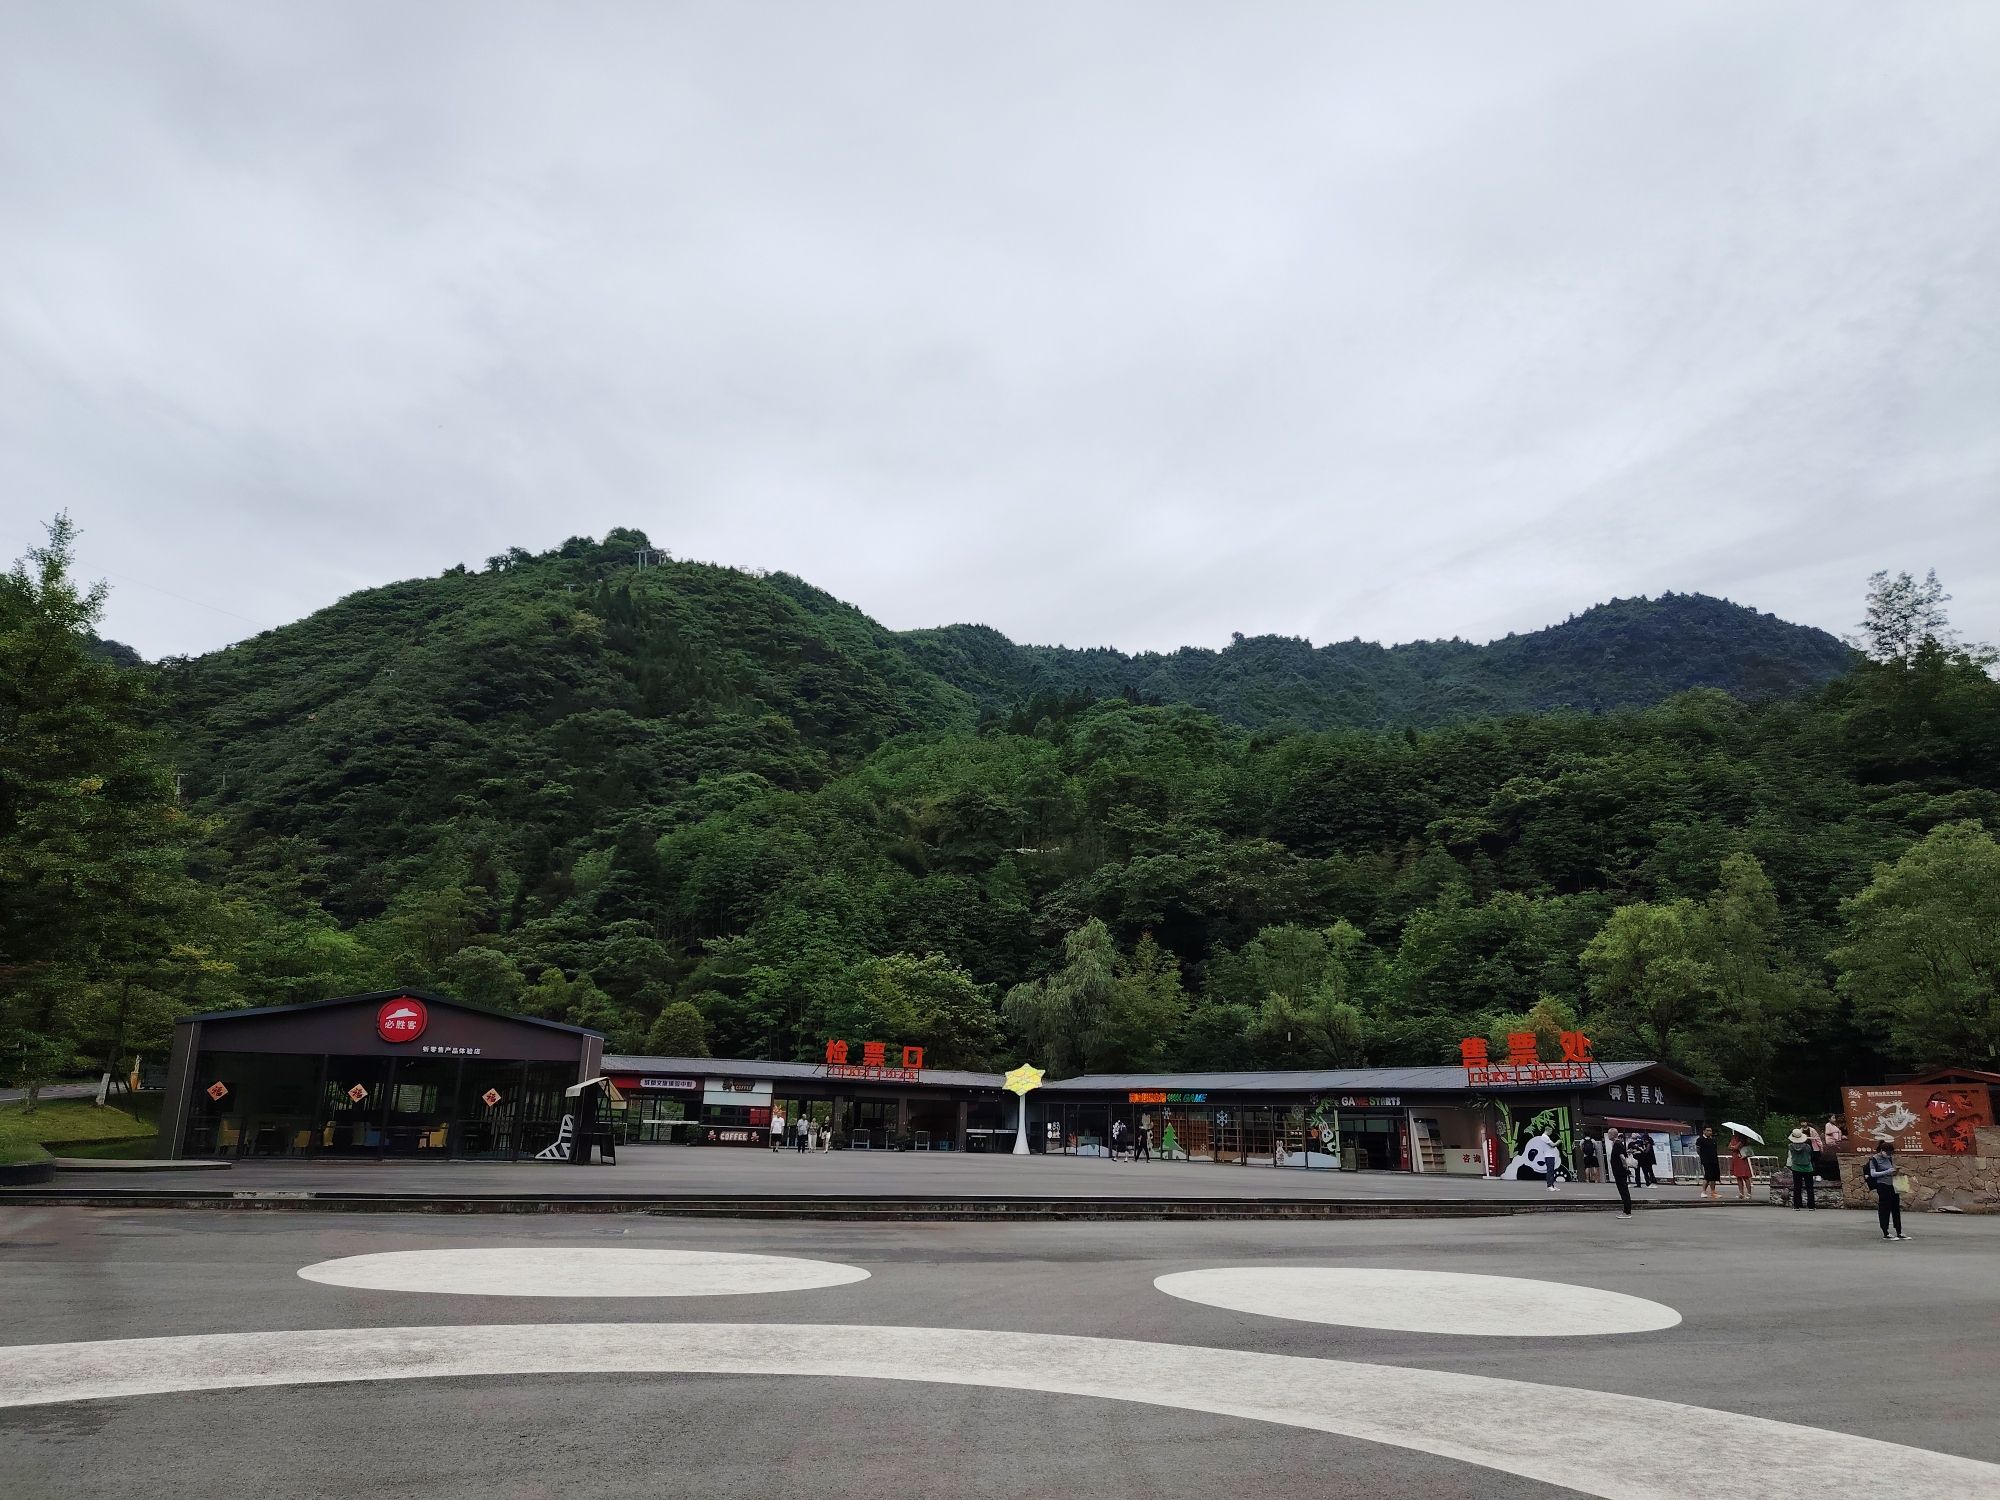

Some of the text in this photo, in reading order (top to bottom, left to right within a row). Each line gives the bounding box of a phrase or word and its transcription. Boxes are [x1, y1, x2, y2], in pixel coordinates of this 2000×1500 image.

[384, 1019, 417, 1030] 必胜客
[422, 1045, 481, 1055] 新零售产品体验店
[825, 1039, 924, 1069] 检票口
[1459, 1030, 1593, 1068] 售票处
[1469, 1067, 1589, 1083] TICKET OFFICE
[1626, 1084, 1665, 1105] 售票处
[719, 1131, 748, 1141] COFFEE
[1463, 1153, 1482, 1164] 咨询
